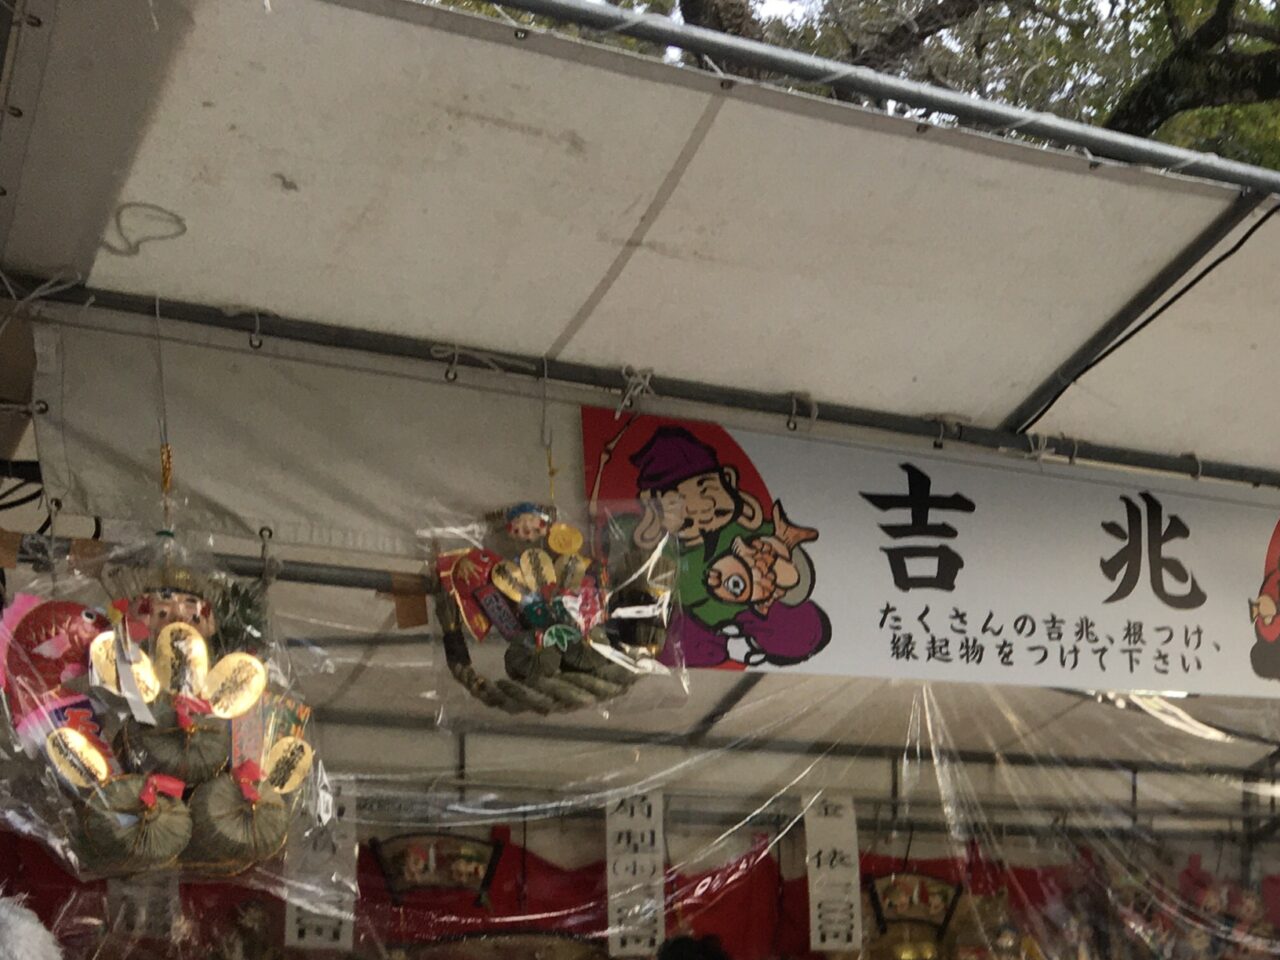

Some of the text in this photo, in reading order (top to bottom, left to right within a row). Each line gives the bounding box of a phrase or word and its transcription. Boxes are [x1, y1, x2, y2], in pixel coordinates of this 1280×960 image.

[878, 602, 1223, 653] たくさんの吉兆、根つけ、
[890, 633, 1204, 676] 縁起物をつけて下さい
